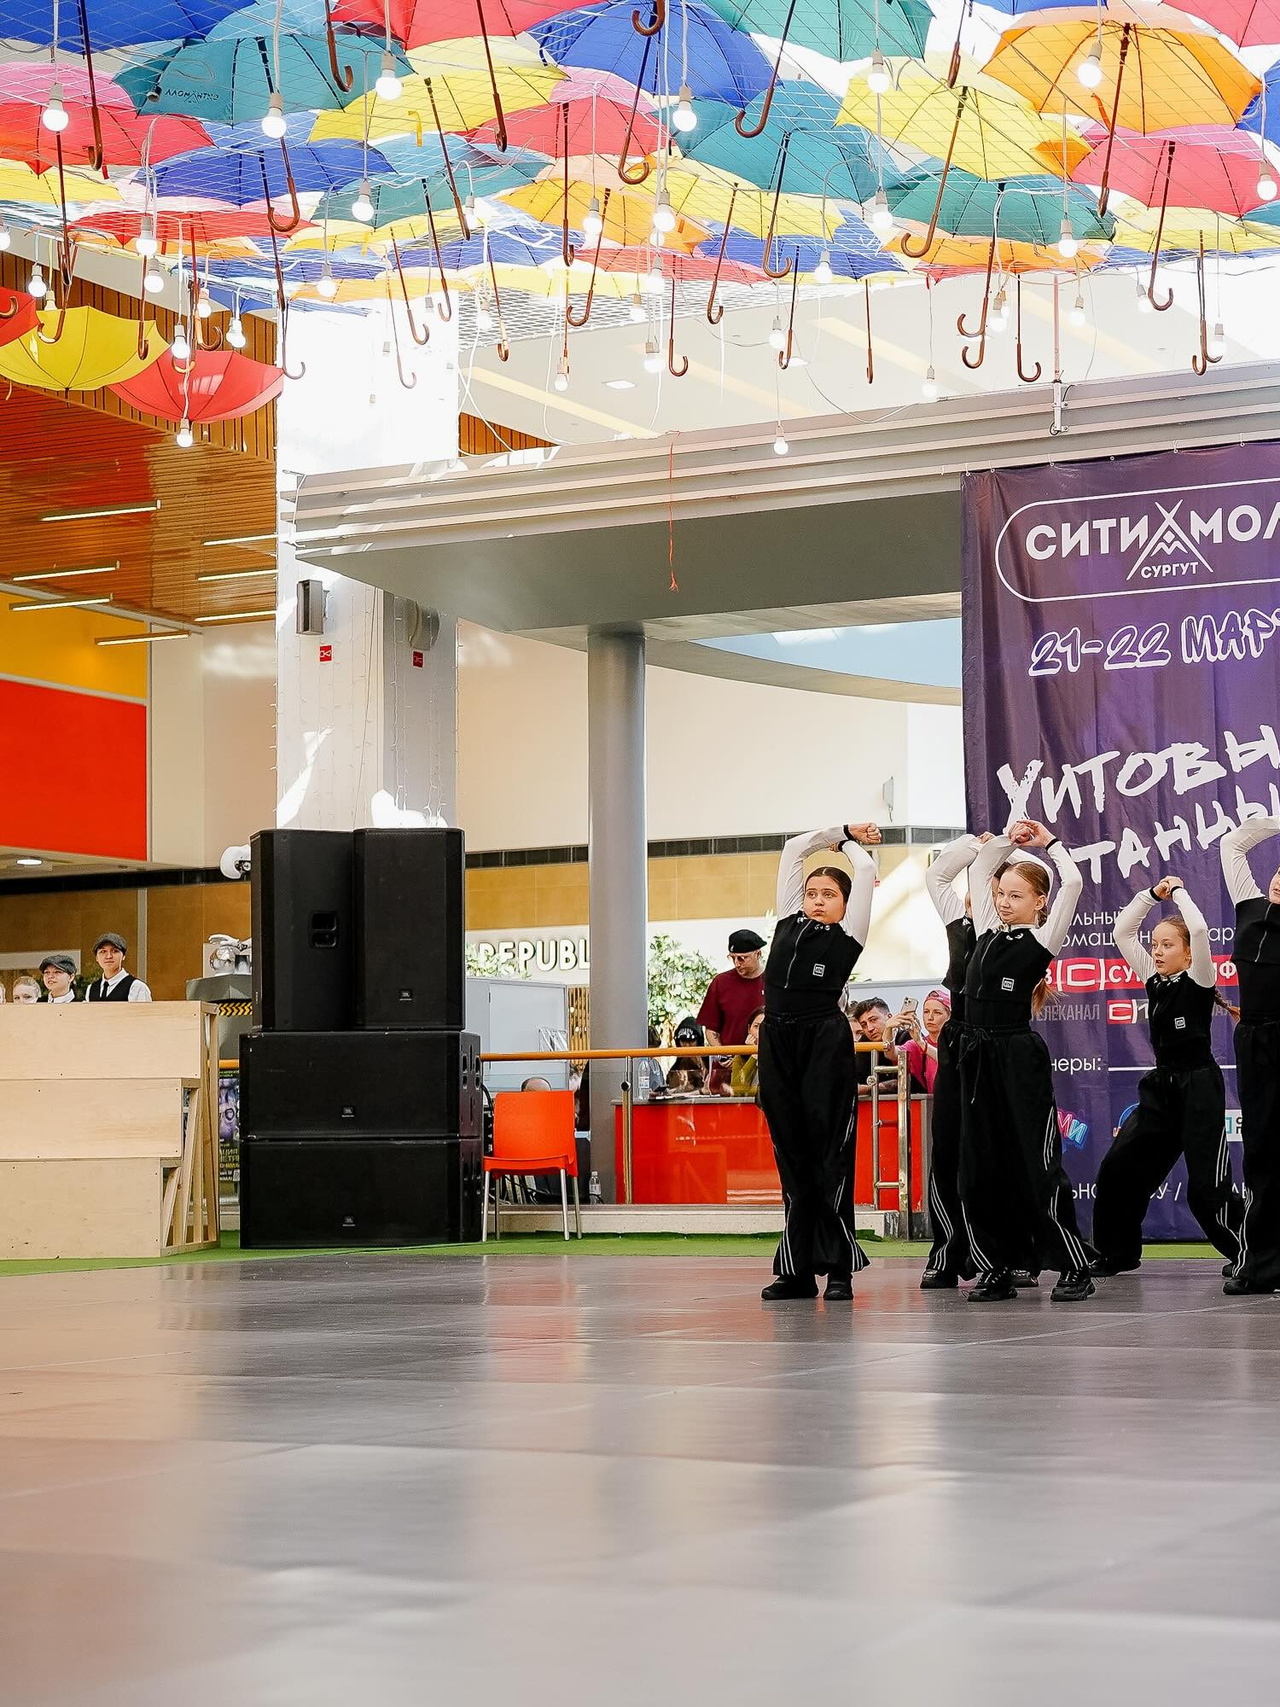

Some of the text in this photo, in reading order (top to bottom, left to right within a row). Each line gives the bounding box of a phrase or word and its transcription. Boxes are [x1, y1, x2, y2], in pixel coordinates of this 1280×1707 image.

[1025, 514, 1149, 561] СИТИ
[1140, 562, 1199, 580] СУРГУТ
[1028, 622, 1172, 677] 21-22
[478, 938, 590, 972] REPUBL
[1032, 1003, 1101, 1022] ЛЕКАНАЛ
[1051, 1056, 1103, 1076] неры:
